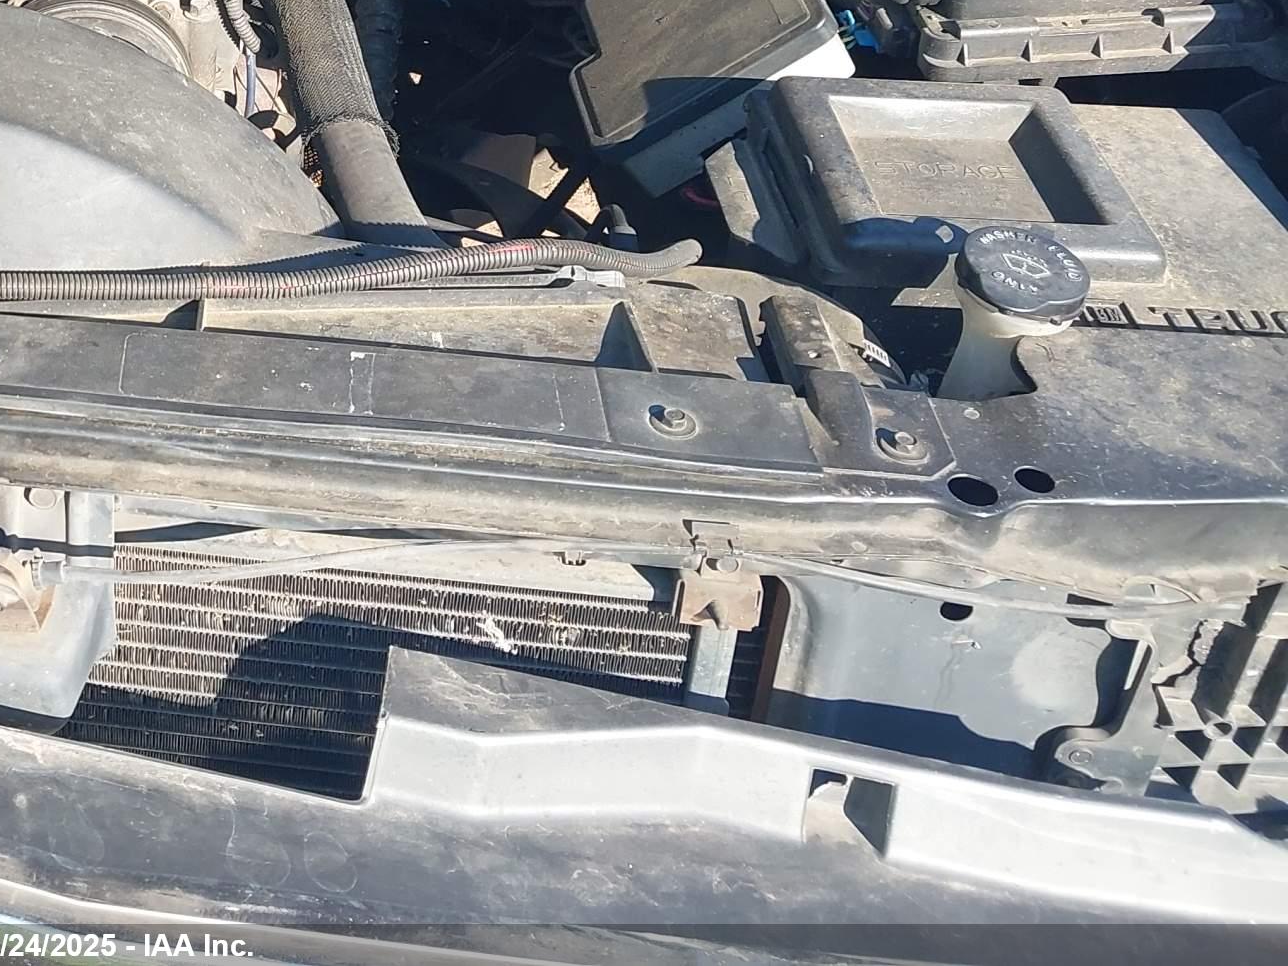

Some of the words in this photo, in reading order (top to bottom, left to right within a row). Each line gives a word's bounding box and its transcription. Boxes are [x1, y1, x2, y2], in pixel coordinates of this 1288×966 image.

[874, 161, 1026, 181] STORAGE
[978, 230, 1037, 244] WASHER
[1047, 245, 1083, 282] FLUID
[992, 270, 1039, 294] ONLY
